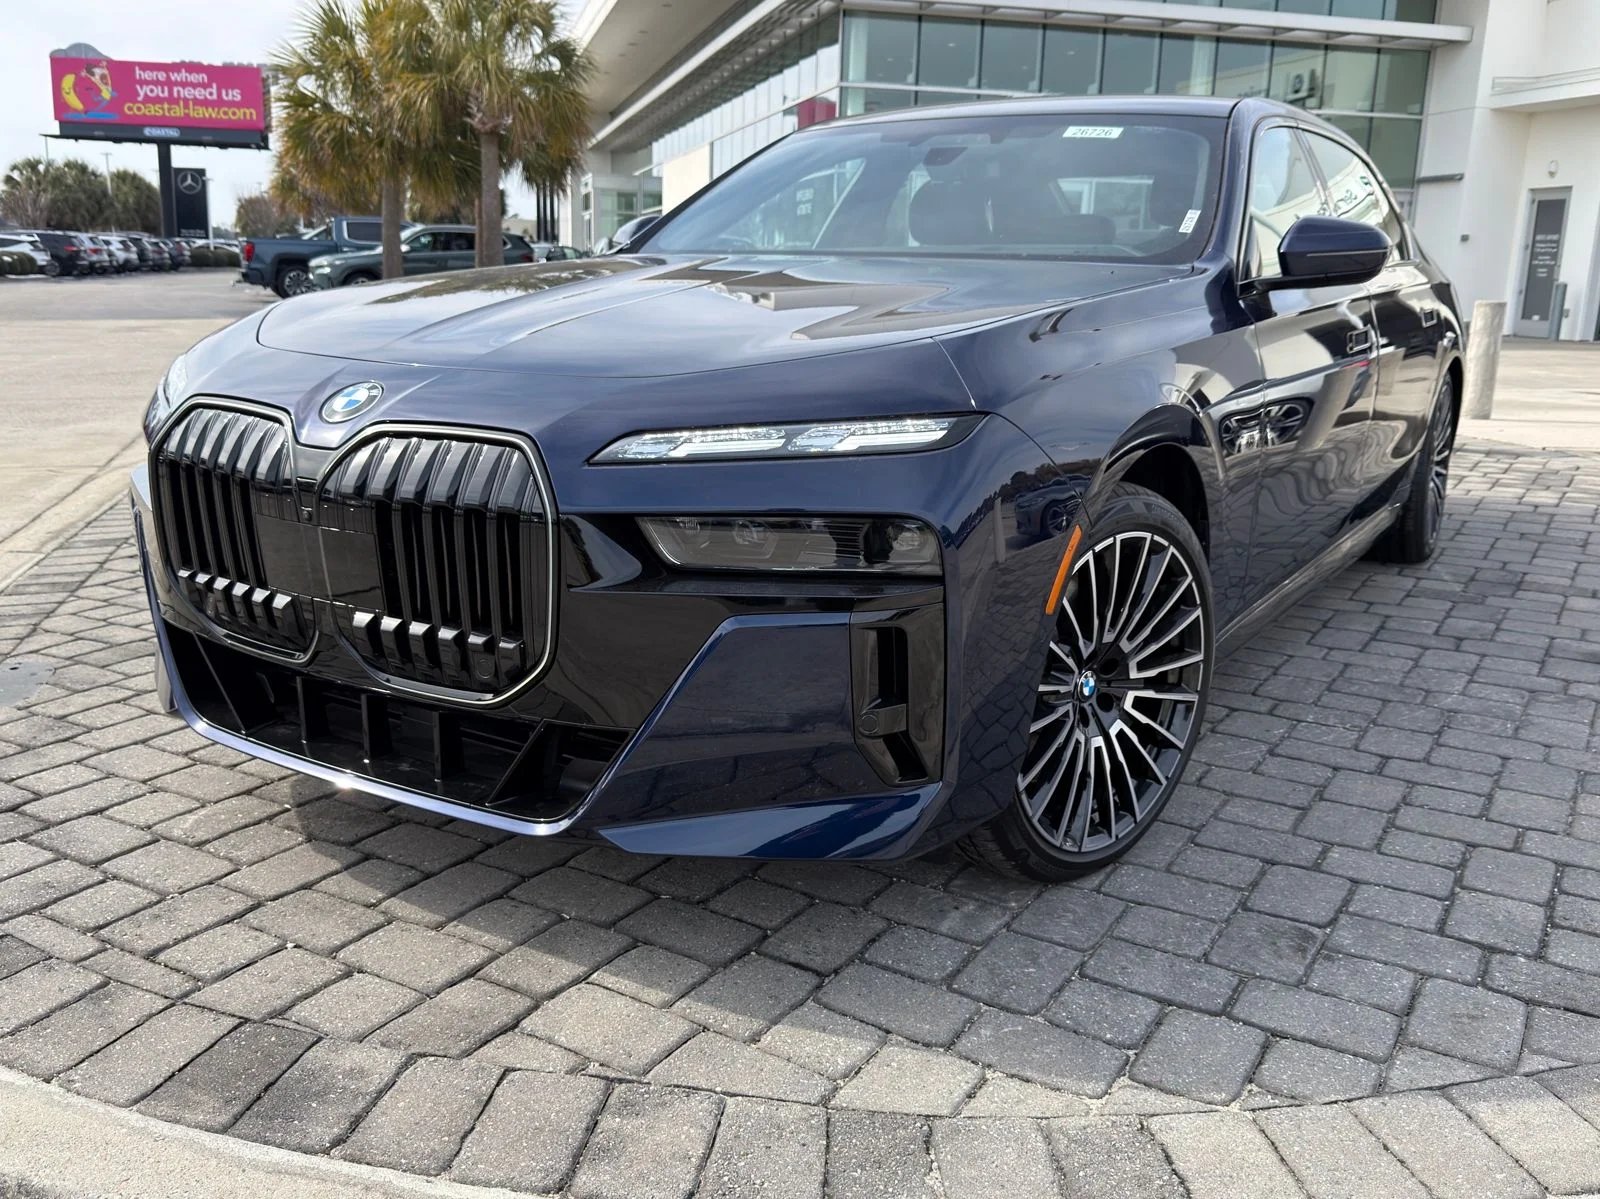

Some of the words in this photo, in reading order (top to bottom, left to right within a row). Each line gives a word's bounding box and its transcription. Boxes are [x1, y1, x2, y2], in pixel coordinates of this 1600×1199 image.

[135, 66, 167, 82] here
[169, 68, 208, 84] when
[135, 84, 169, 101] you
[173, 83, 218, 100] need
[221, 87, 242, 102] us
[123, 101, 257, 121] coastal-law.com
[1071, 128, 1114, 137] 26726
